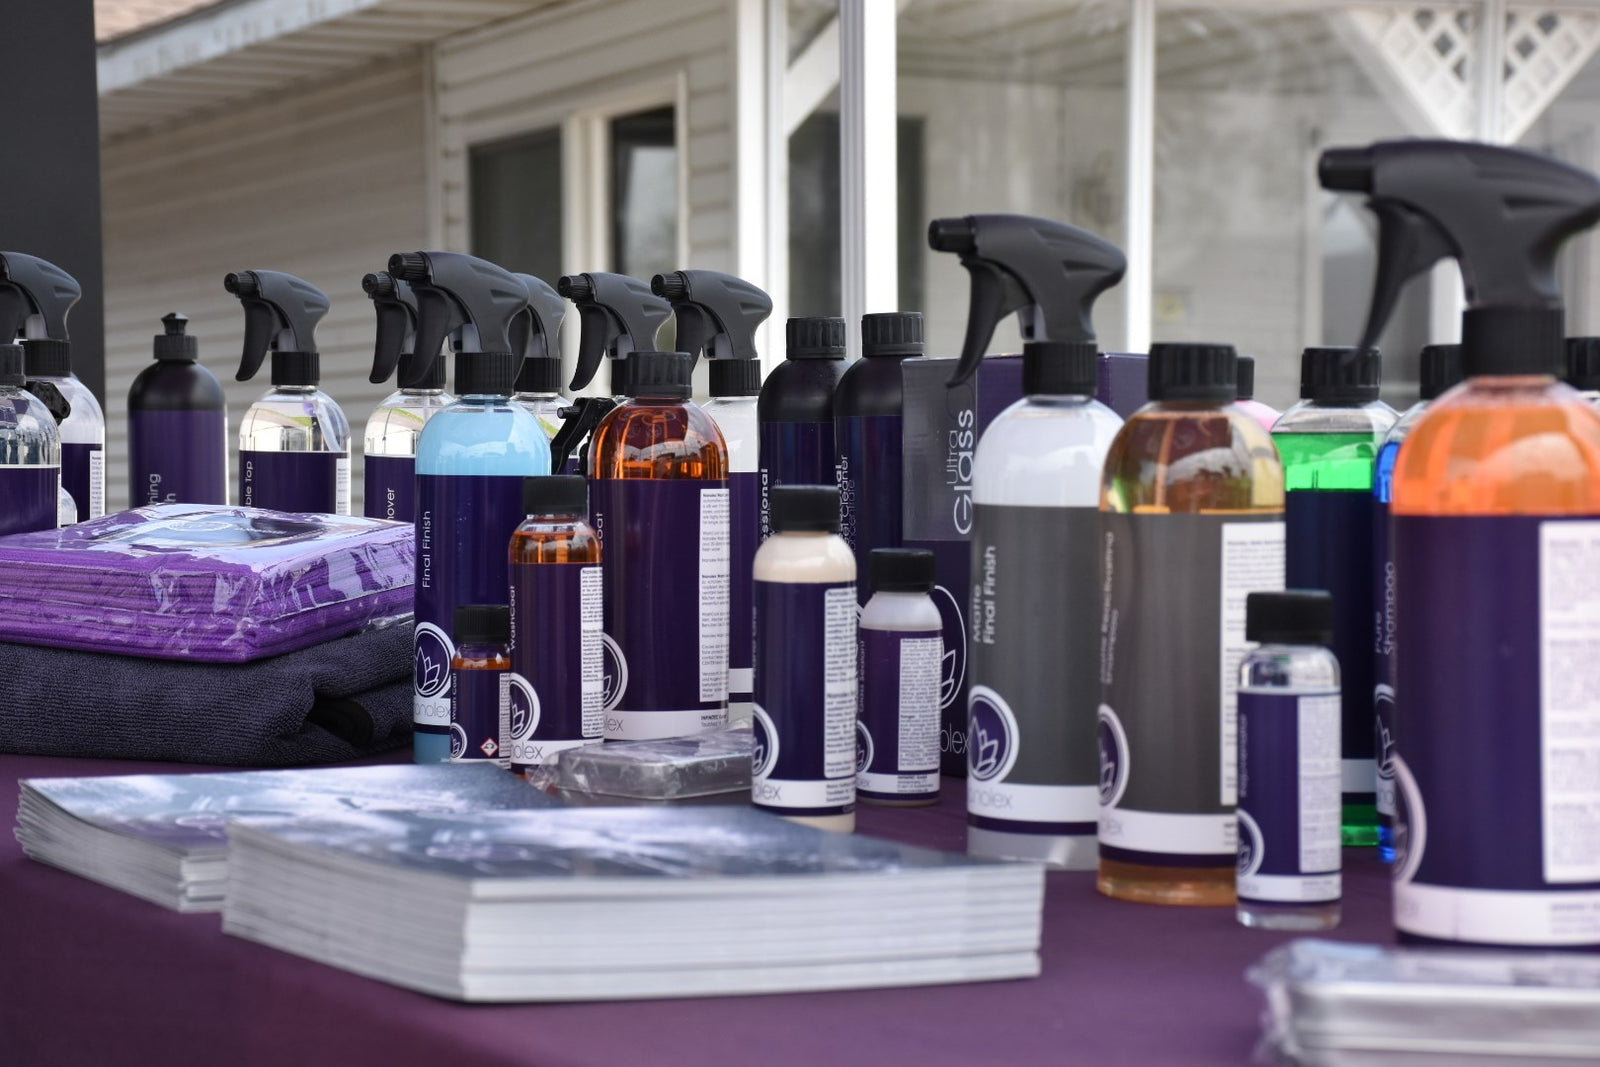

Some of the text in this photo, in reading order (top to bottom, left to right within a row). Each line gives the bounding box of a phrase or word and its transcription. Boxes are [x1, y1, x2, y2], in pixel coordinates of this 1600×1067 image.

[245, 460, 253, 482] Top
[946, 430, 958, 484] Ultra
[953, 409, 974, 535] Glass
[422, 511, 431, 588] Final Finish
[983, 546, 996, 644] Final Finish
[604, 714, 624, 732] lex
